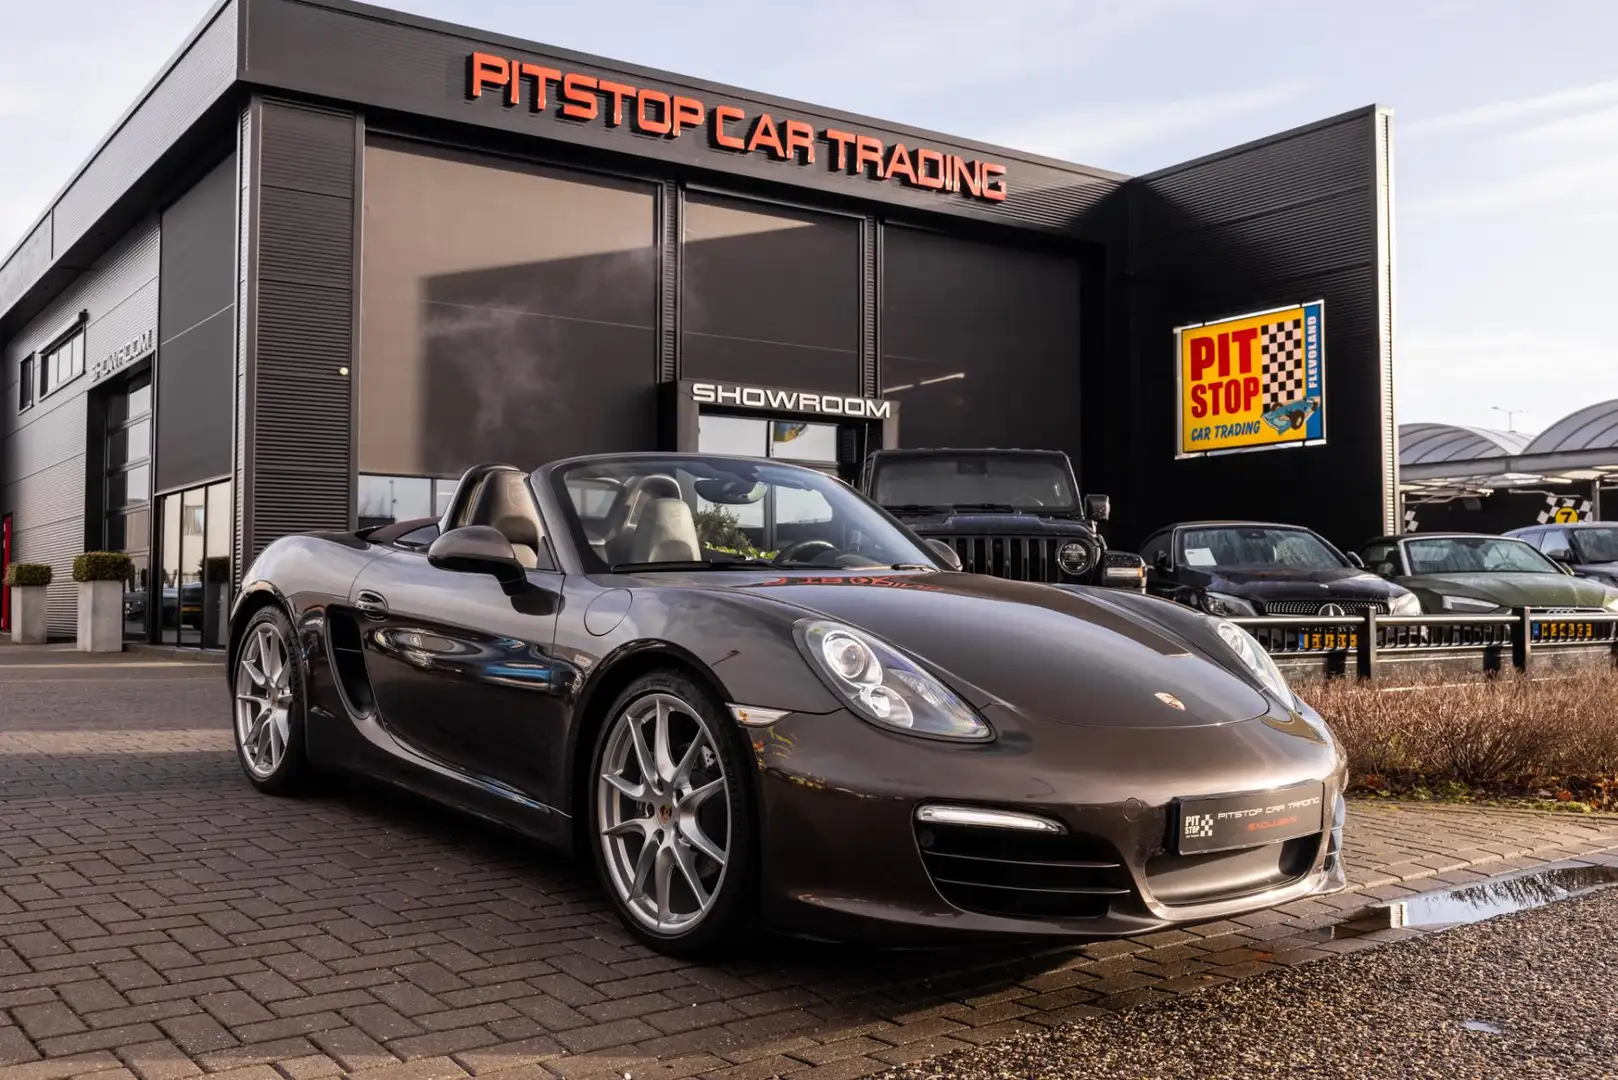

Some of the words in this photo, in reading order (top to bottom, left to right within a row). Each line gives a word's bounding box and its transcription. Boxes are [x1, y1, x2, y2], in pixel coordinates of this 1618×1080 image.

[471, 51, 705, 138] PITSTOP
[712, 105, 815, 164] CAR
[824, 128, 1007, 202] TRADING
[1190, 327, 1258, 381] PIT
[1307, 315, 1318, 389] FLEVOLAND
[692, 383, 891, 418] SHOWROOM
[1191, 376, 1260, 419] STOP
[1191, 426, 1211, 442] CAR
[1215, 421, 1261, 438] TRADING
[1560, 511, 1573, 523] 7
[1185, 815, 1200, 826] PIT
[1217, 807, 1263, 820] PITSTOP
[1265, 804, 1285, 814] CAR
[1185, 825, 1200, 835] STOP
